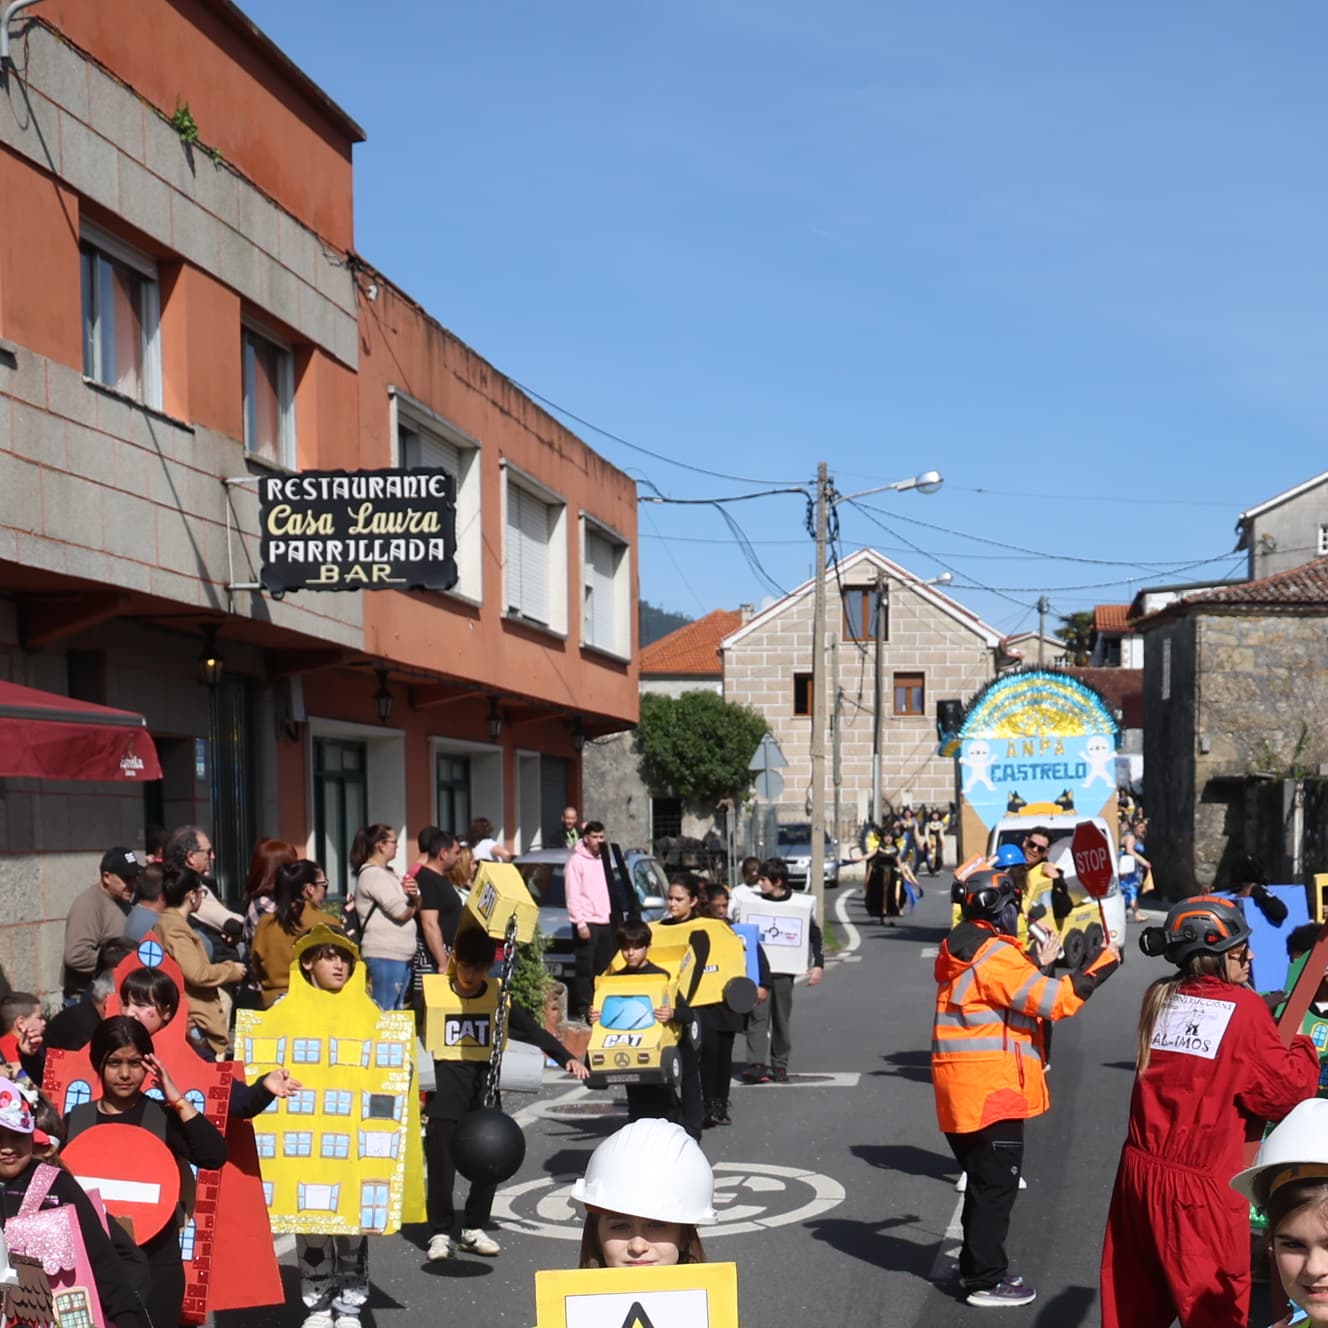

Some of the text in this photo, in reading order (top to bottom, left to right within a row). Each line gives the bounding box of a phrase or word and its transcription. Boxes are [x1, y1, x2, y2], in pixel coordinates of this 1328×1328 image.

[267, 475, 446, 501] RESTAURANTE
[267, 502, 441, 536] Casa Laura
[268, 538, 445, 563] PARRILLADA
[309, 564, 404, 584] BAR
[1006, 738, 1065, 758] ANPA
[990, 762, 1087, 782] CASTRELO
[1075, 847, 1107, 874] STOP
[445, 1020, 490, 1047] CAT
[603, 1034, 644, 1048] CAT
